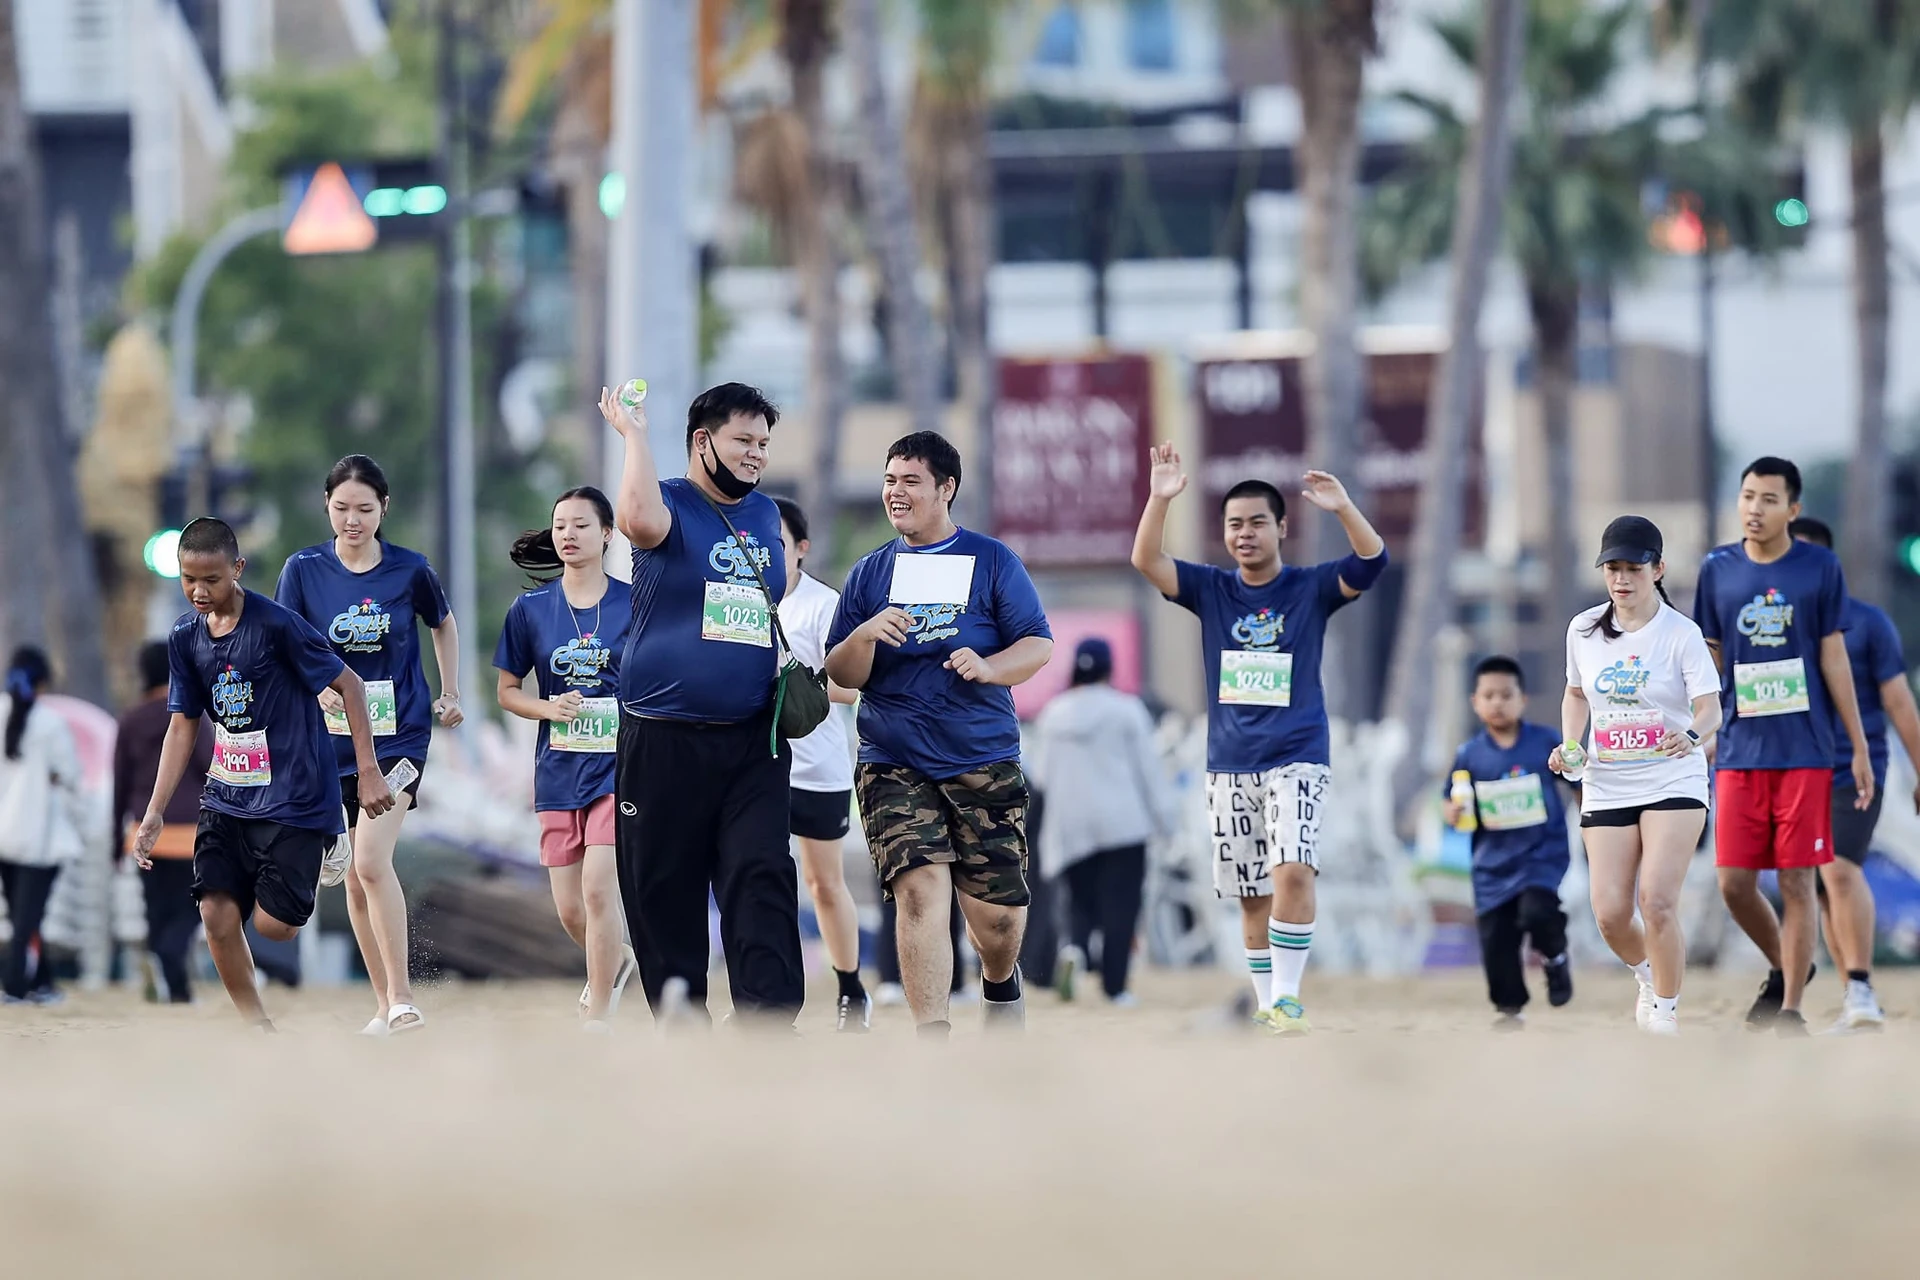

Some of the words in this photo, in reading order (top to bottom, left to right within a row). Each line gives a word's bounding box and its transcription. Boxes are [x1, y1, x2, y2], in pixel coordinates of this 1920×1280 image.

[723, 604, 759, 628] 1023
[1234, 669, 1275, 690] 1024
[1752, 679, 1790, 701] 1016
[565, 717, 604, 737] 1041
[1609, 729, 1648, 749] 5165
[222, 748, 250, 771] 5199
